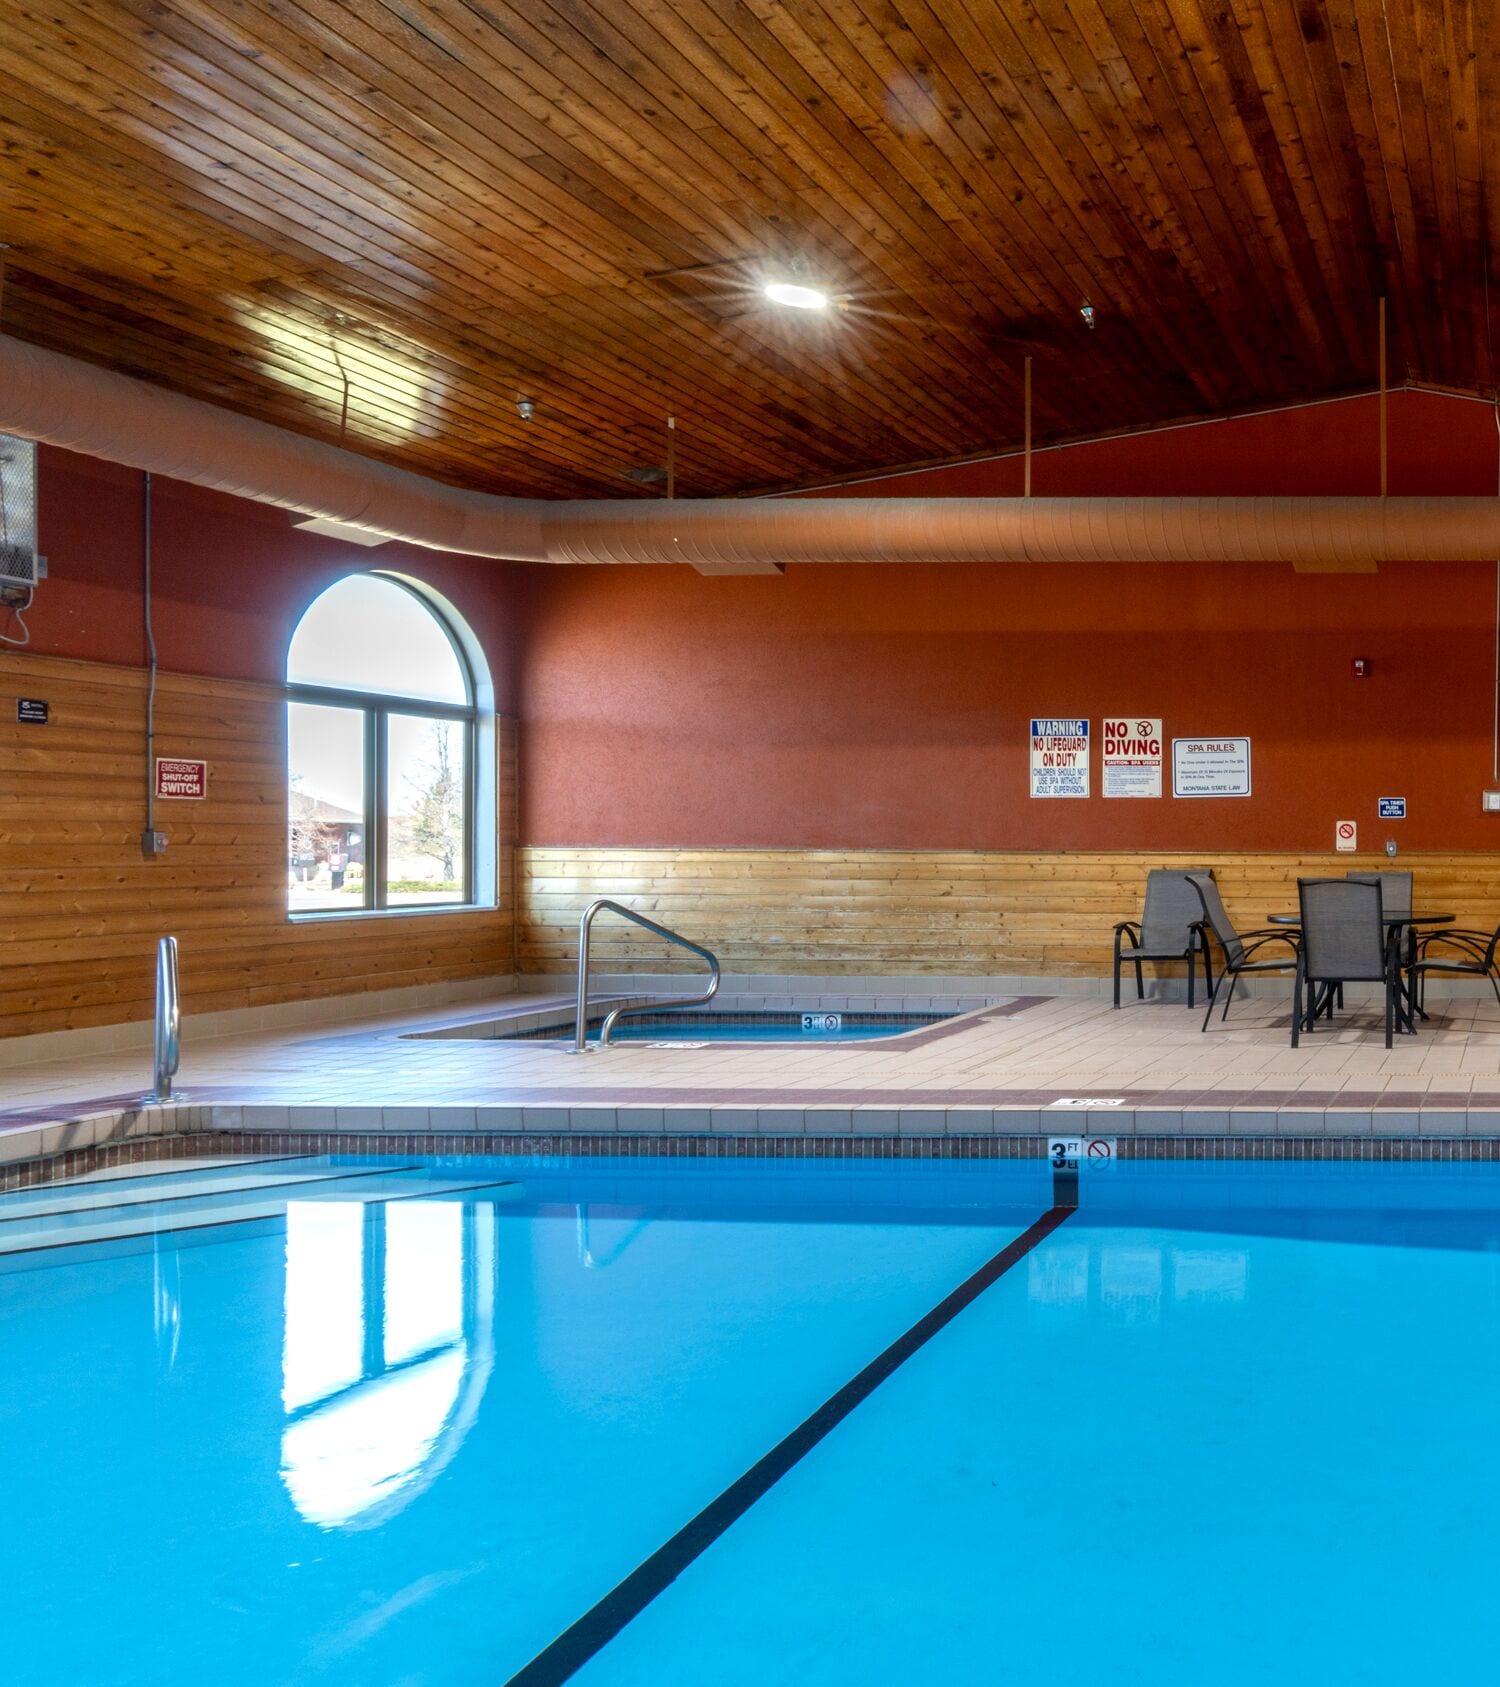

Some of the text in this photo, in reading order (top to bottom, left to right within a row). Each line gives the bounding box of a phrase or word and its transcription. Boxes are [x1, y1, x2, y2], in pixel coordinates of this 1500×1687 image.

[1037, 721, 1083, 736] WARNING
[1105, 722, 1128, 738] NO
[1033, 737, 1087, 751] NO LIFEGUARD
[1105, 739, 1160, 755] DIVING
[1187, 743, 1235, 752] SPA RULES
[1043, 753, 1077, 767] ON DUTY
[161, 763, 200, 773] EMERGENCY
[1033, 768, 1087, 776] CHILDREN SHOULD NOT
[162, 773, 199, 782] SHUT-OFF
[1038, 777, 1082, 785] USE SPA WITHOUT
[161, 782, 200, 793] SWITCH
[804, 1016, 813, 1029] 3
[1052, 1143, 1079, 1159] 3 FT
